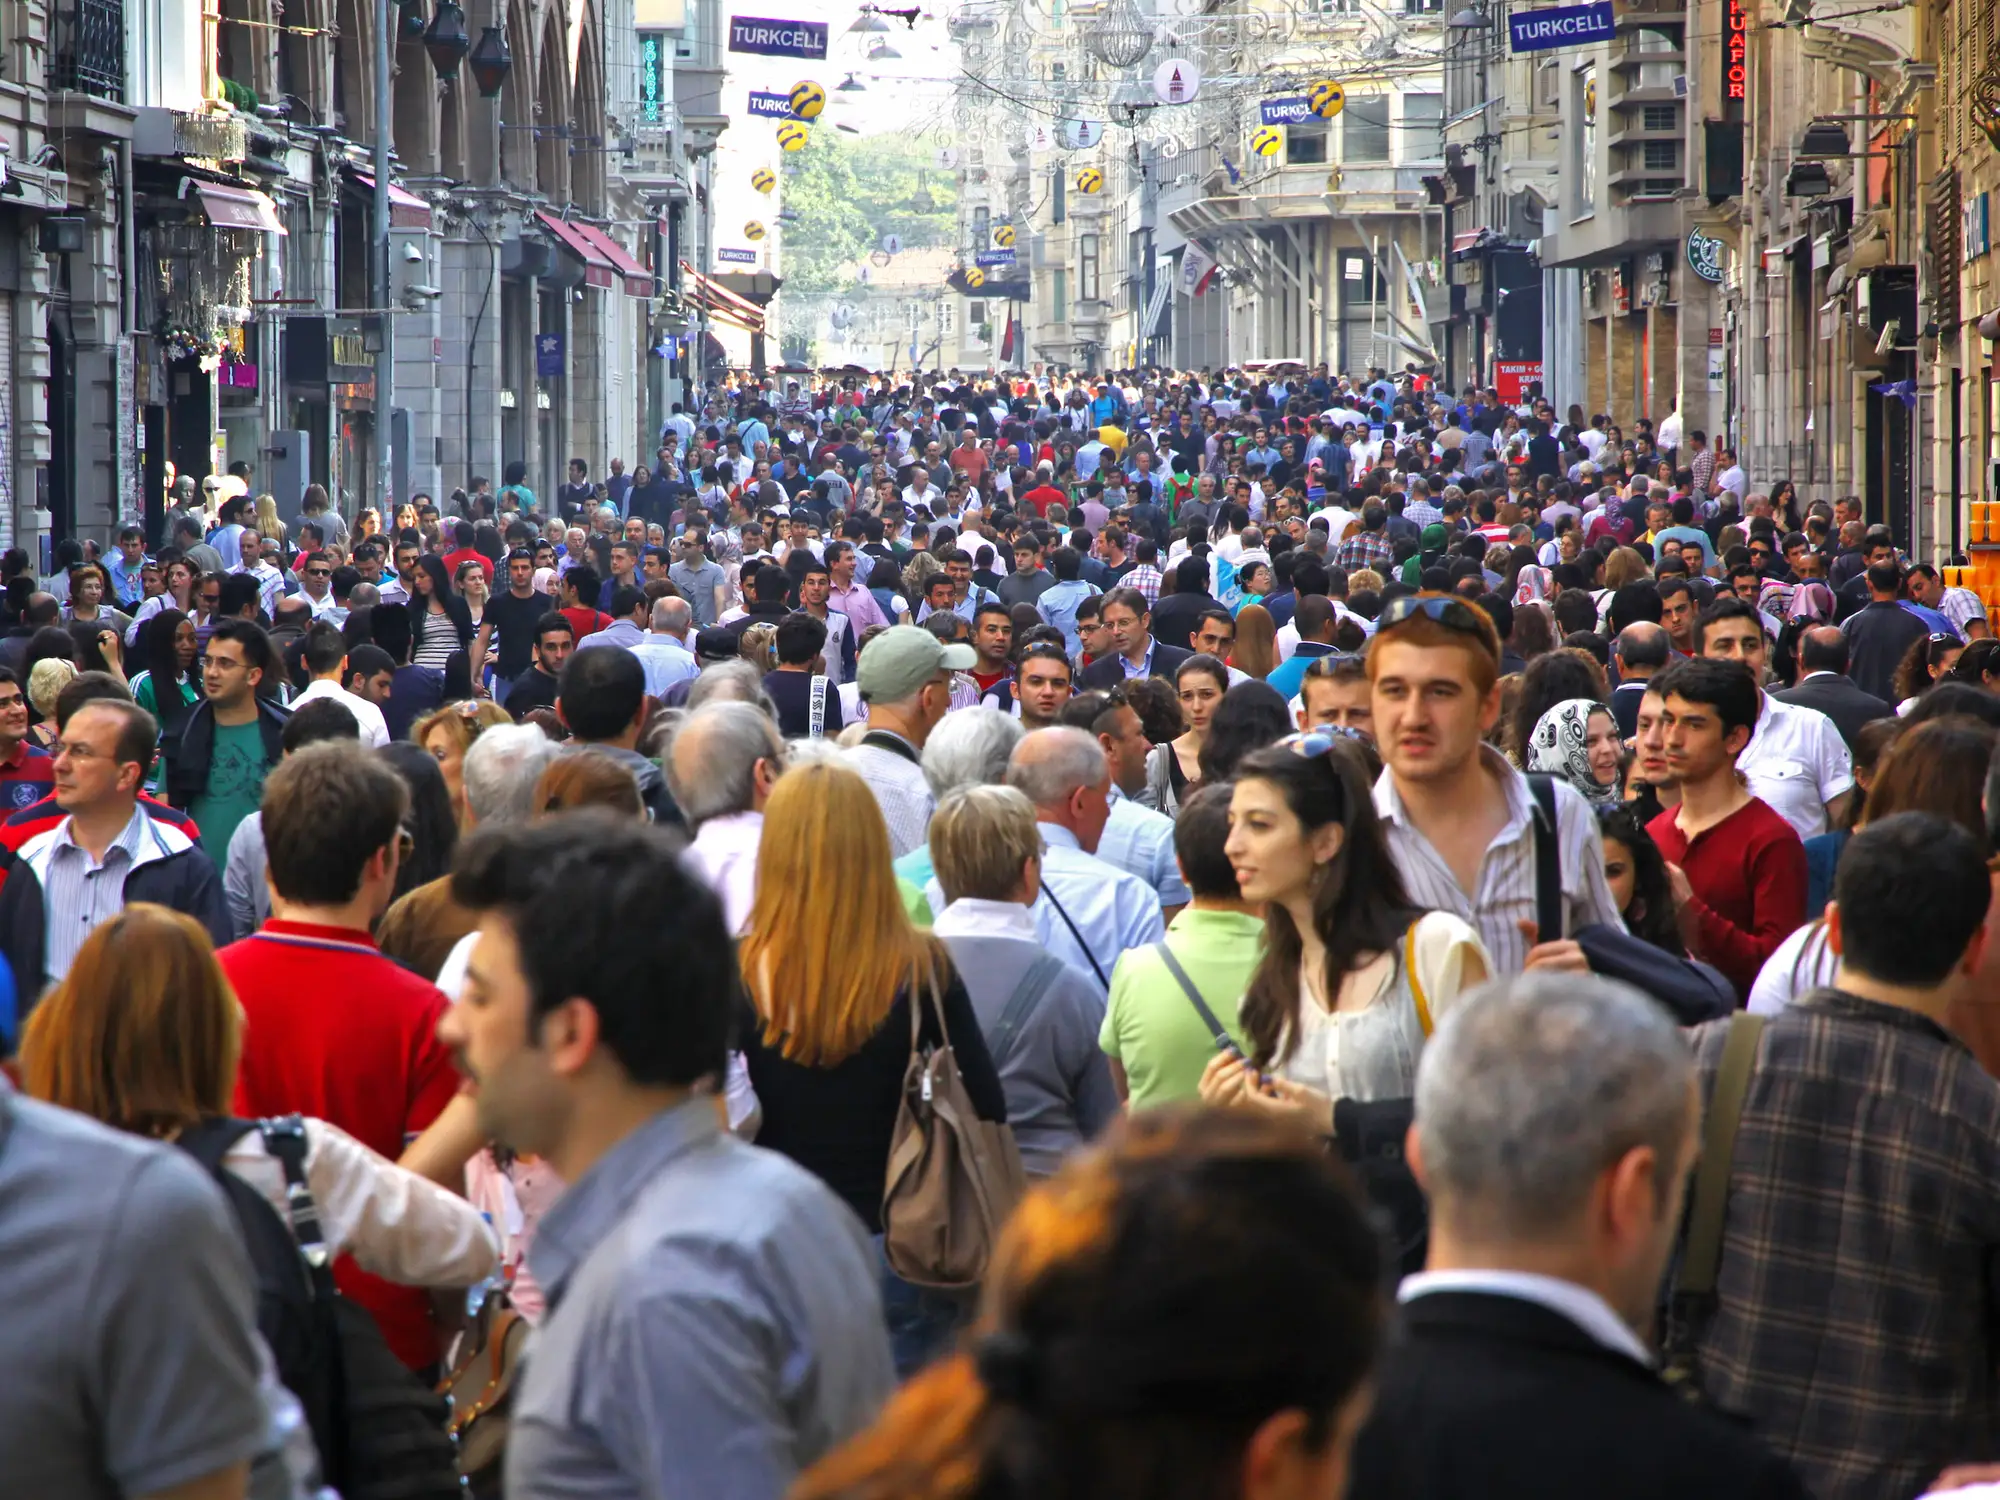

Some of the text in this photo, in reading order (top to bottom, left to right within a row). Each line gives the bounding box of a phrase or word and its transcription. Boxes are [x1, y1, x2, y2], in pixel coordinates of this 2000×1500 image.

[1514, 14, 1609, 40] TURKCELL
[733, 26, 824, 49] TURKCELL
[751, 97, 794, 113] TURKC
[720, 250, 755, 260] TURKCELL
